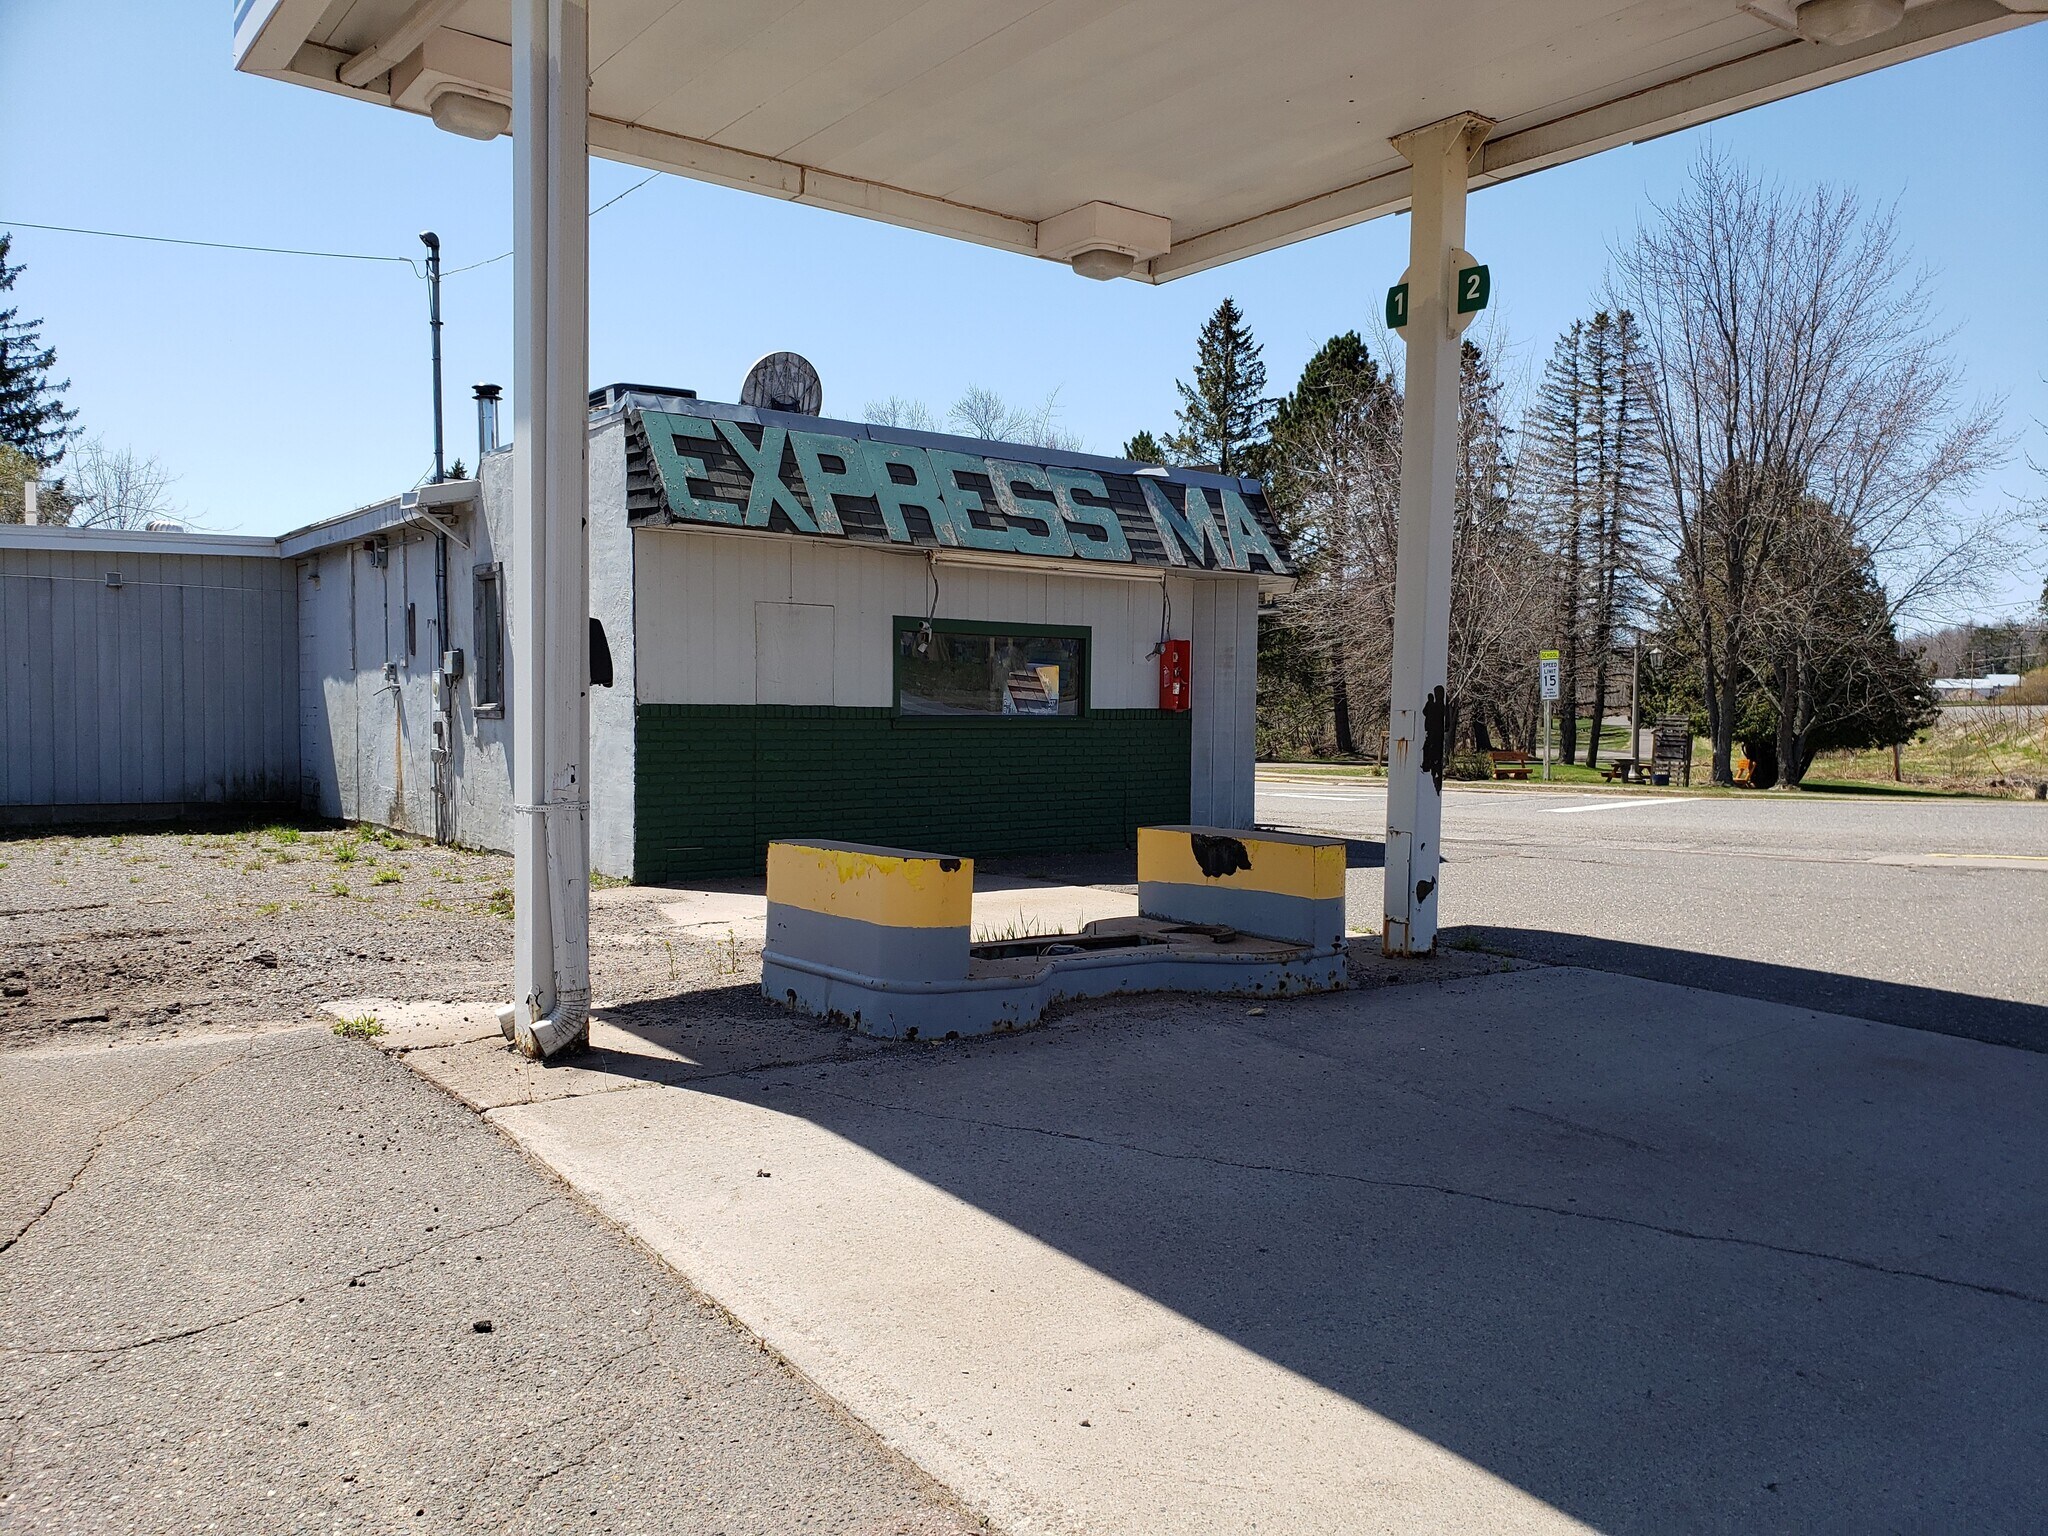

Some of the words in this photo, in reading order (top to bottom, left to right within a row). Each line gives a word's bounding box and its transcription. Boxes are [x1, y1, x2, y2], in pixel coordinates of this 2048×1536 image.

[1466, 274, 1480, 299] 2
[1394, 292, 1403, 315] 1
[640, 410, 1132, 562] EXPRESS
[1137, 476, 1288, 574] MA
[1544, 675, 1556, 687] 15
